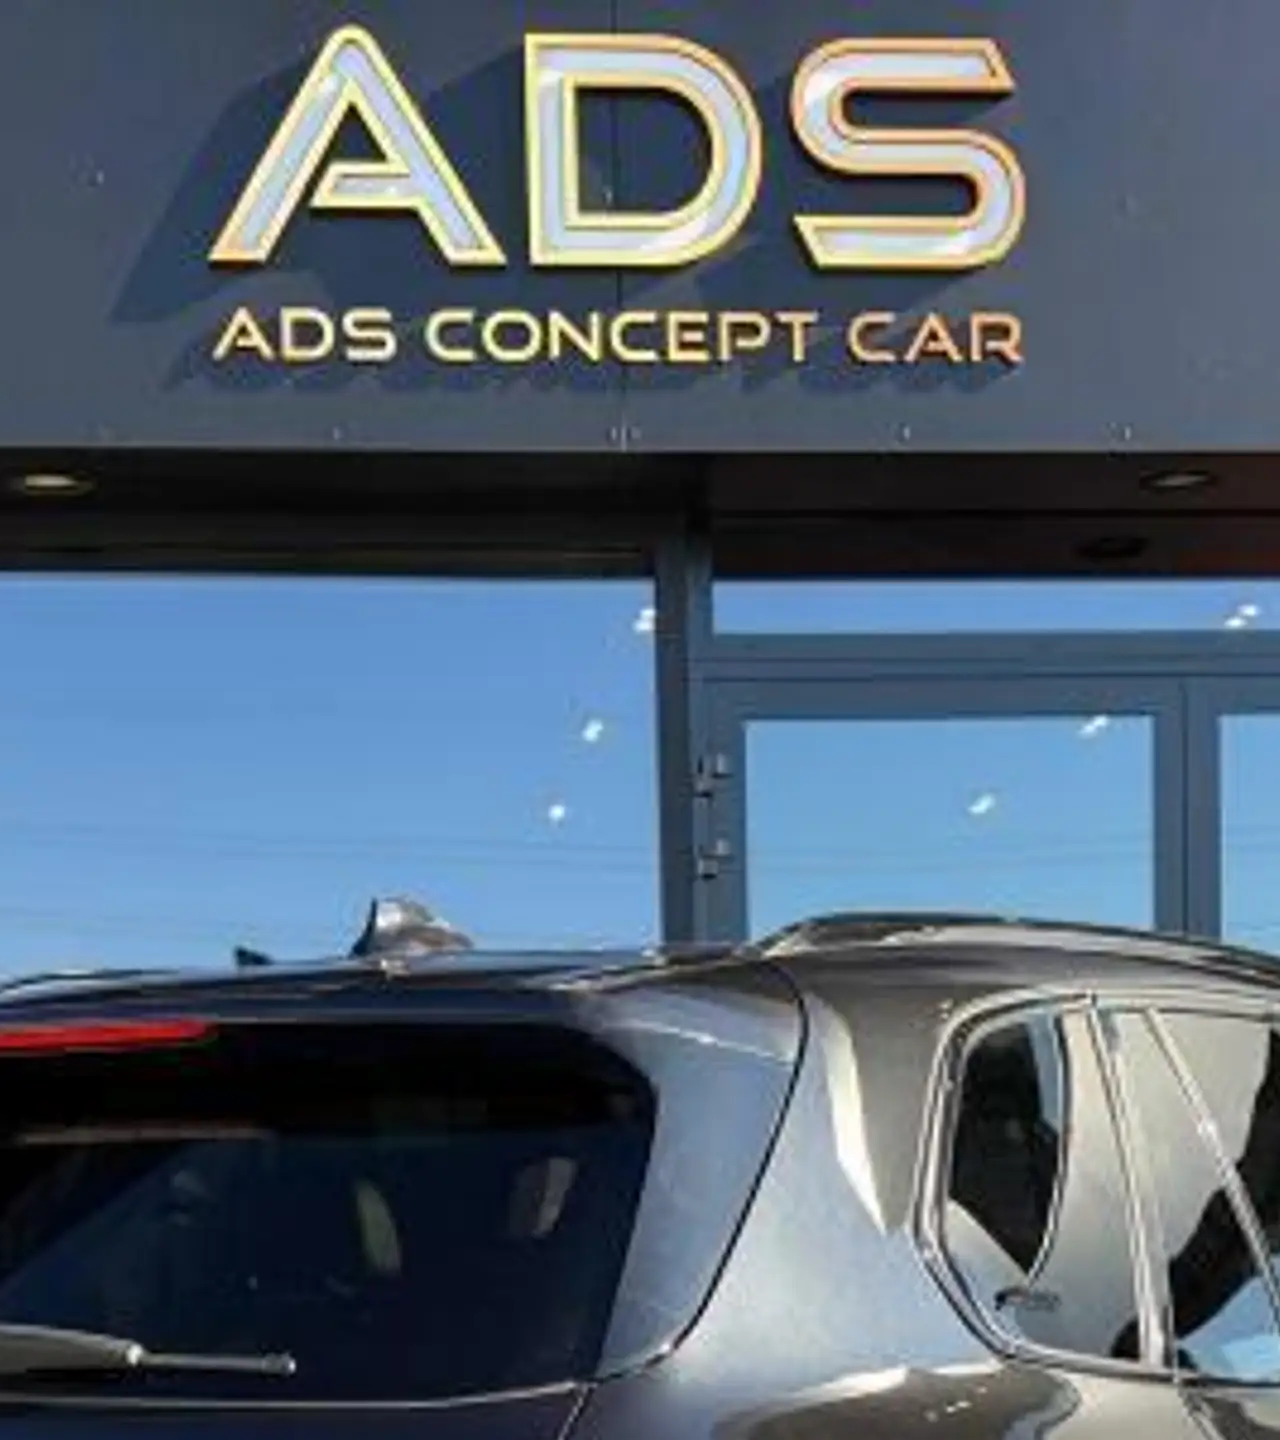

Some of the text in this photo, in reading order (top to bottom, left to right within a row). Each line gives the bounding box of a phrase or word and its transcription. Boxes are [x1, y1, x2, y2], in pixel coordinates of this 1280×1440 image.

[208, 23, 1026, 269] ADS
[212, 307, 1025, 363] ADS CONCEPT CAR
